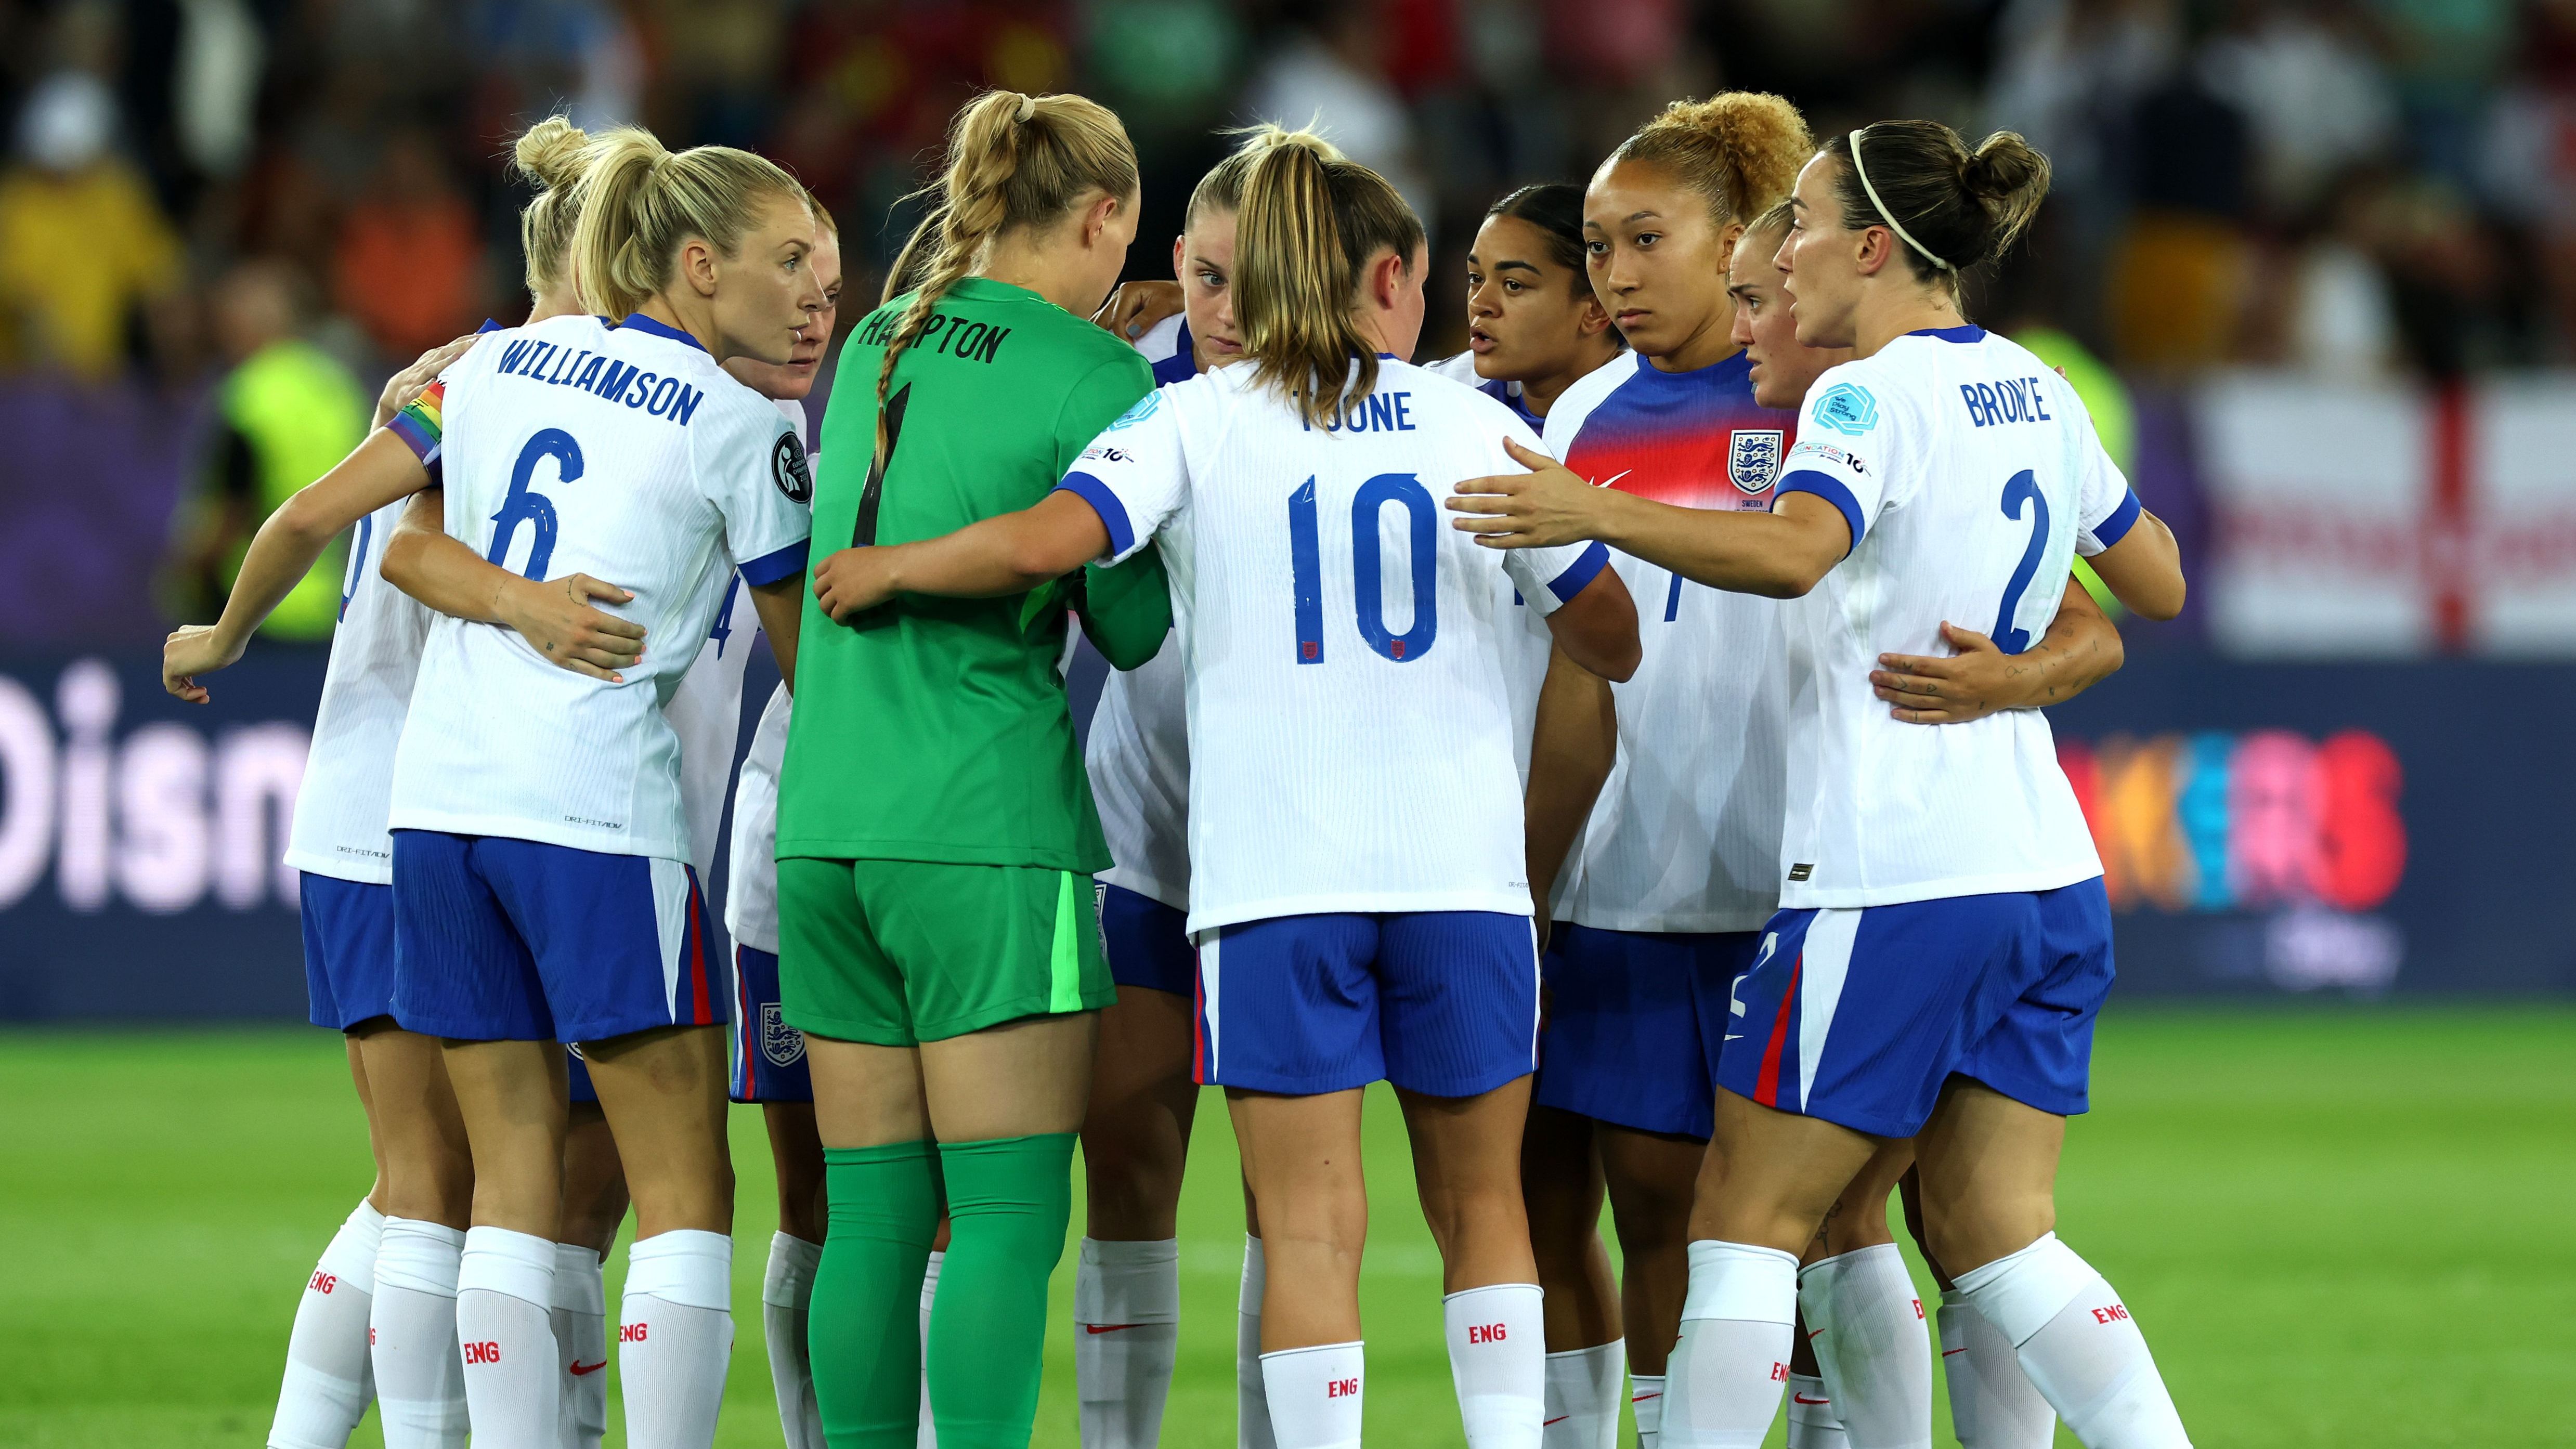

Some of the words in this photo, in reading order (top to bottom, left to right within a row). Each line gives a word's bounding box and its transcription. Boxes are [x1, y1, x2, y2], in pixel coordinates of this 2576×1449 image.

[858, 310, 1012, 364] HAPTON
[497, 339, 704, 427] WILLIAMSON
[1832, 402, 1850, 412] play
[851, 381, 912, 548] 1
[488, 428, 584, 583] 6
[1288, 473, 1437, 664] 10
[1991, 469, 2050, 655] 2
[309, 1271, 337, 1295] ENG
[2091, 1304, 2128, 1325] ENG
[619, 1323, 647, 1342] ENG
[1469, 1323, 1506, 1344] ENG
[464, 1341, 500, 1364] ENG
[1329, 1378, 1358, 1399] ENG
